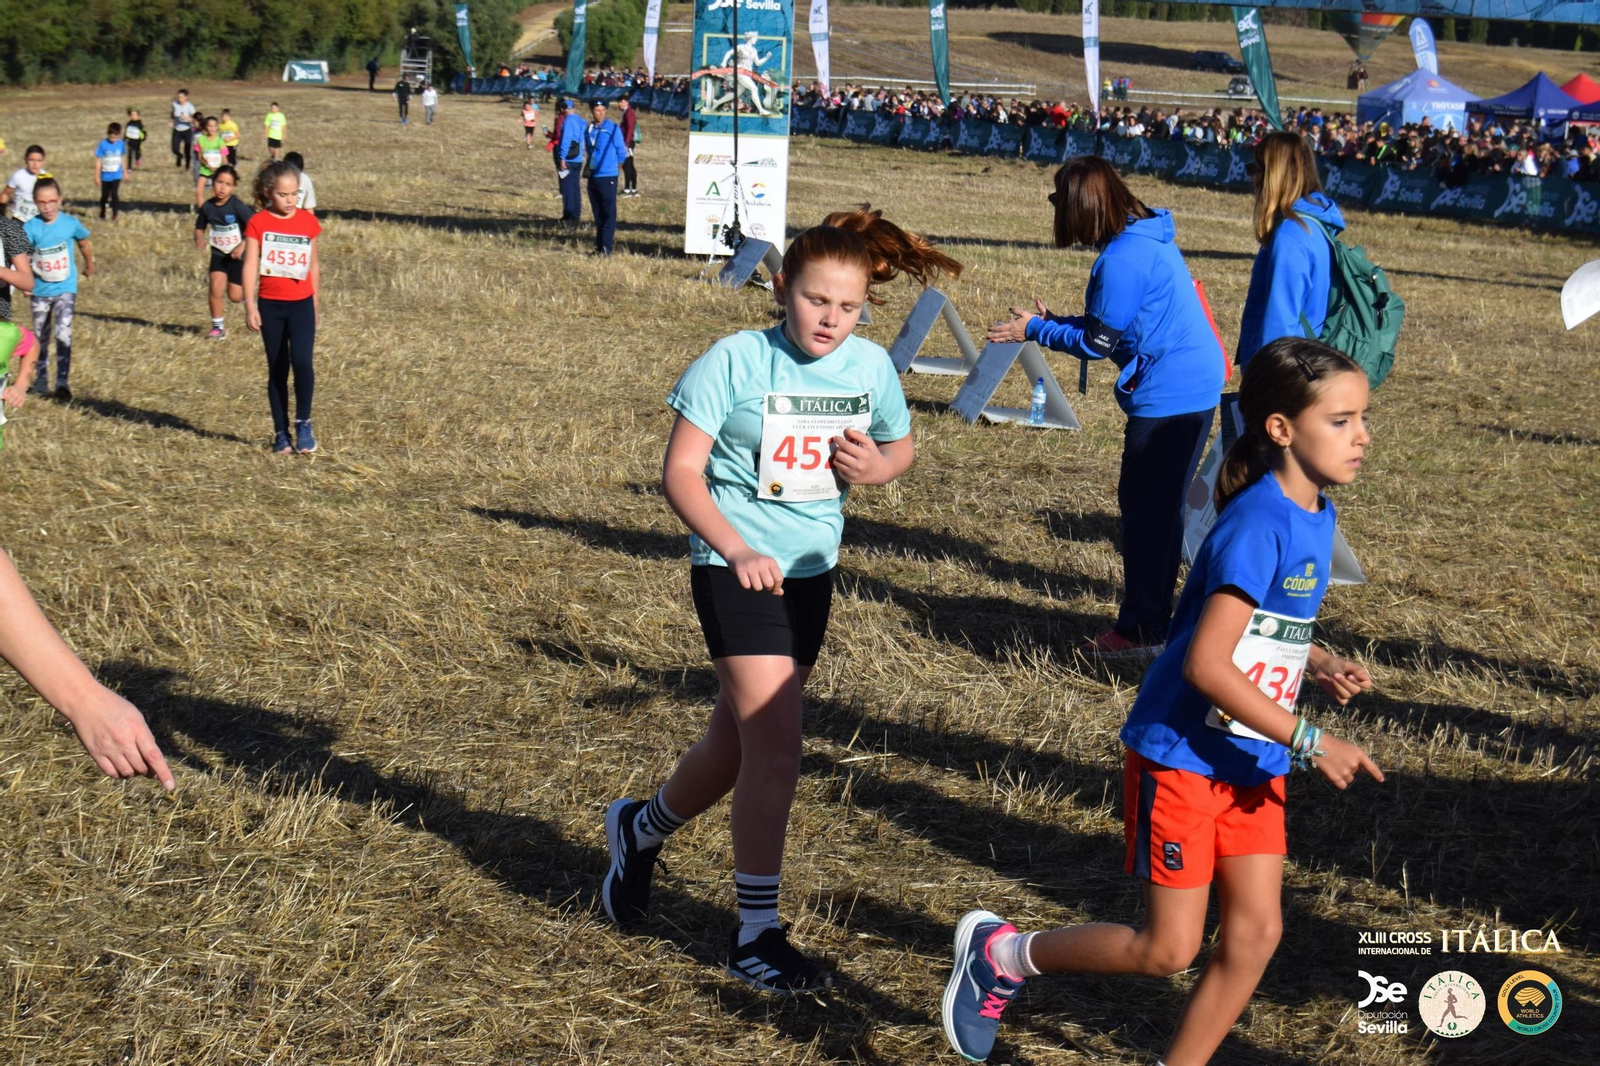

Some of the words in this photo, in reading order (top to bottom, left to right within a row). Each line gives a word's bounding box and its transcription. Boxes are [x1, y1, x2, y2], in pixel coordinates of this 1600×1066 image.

[745, 0, 782, 11] Sevilla
[1337, 180, 1363, 198] Sevilla
[1397, 187, 1424, 204] Sevilla
[1457, 194, 1486, 210] Sevilla
[212, 235, 239, 247] 4533
[36, 256, 68, 273] 4342
[266, 249, 308, 268] 4534
[799, 397, 852, 412] ITÁLICA
